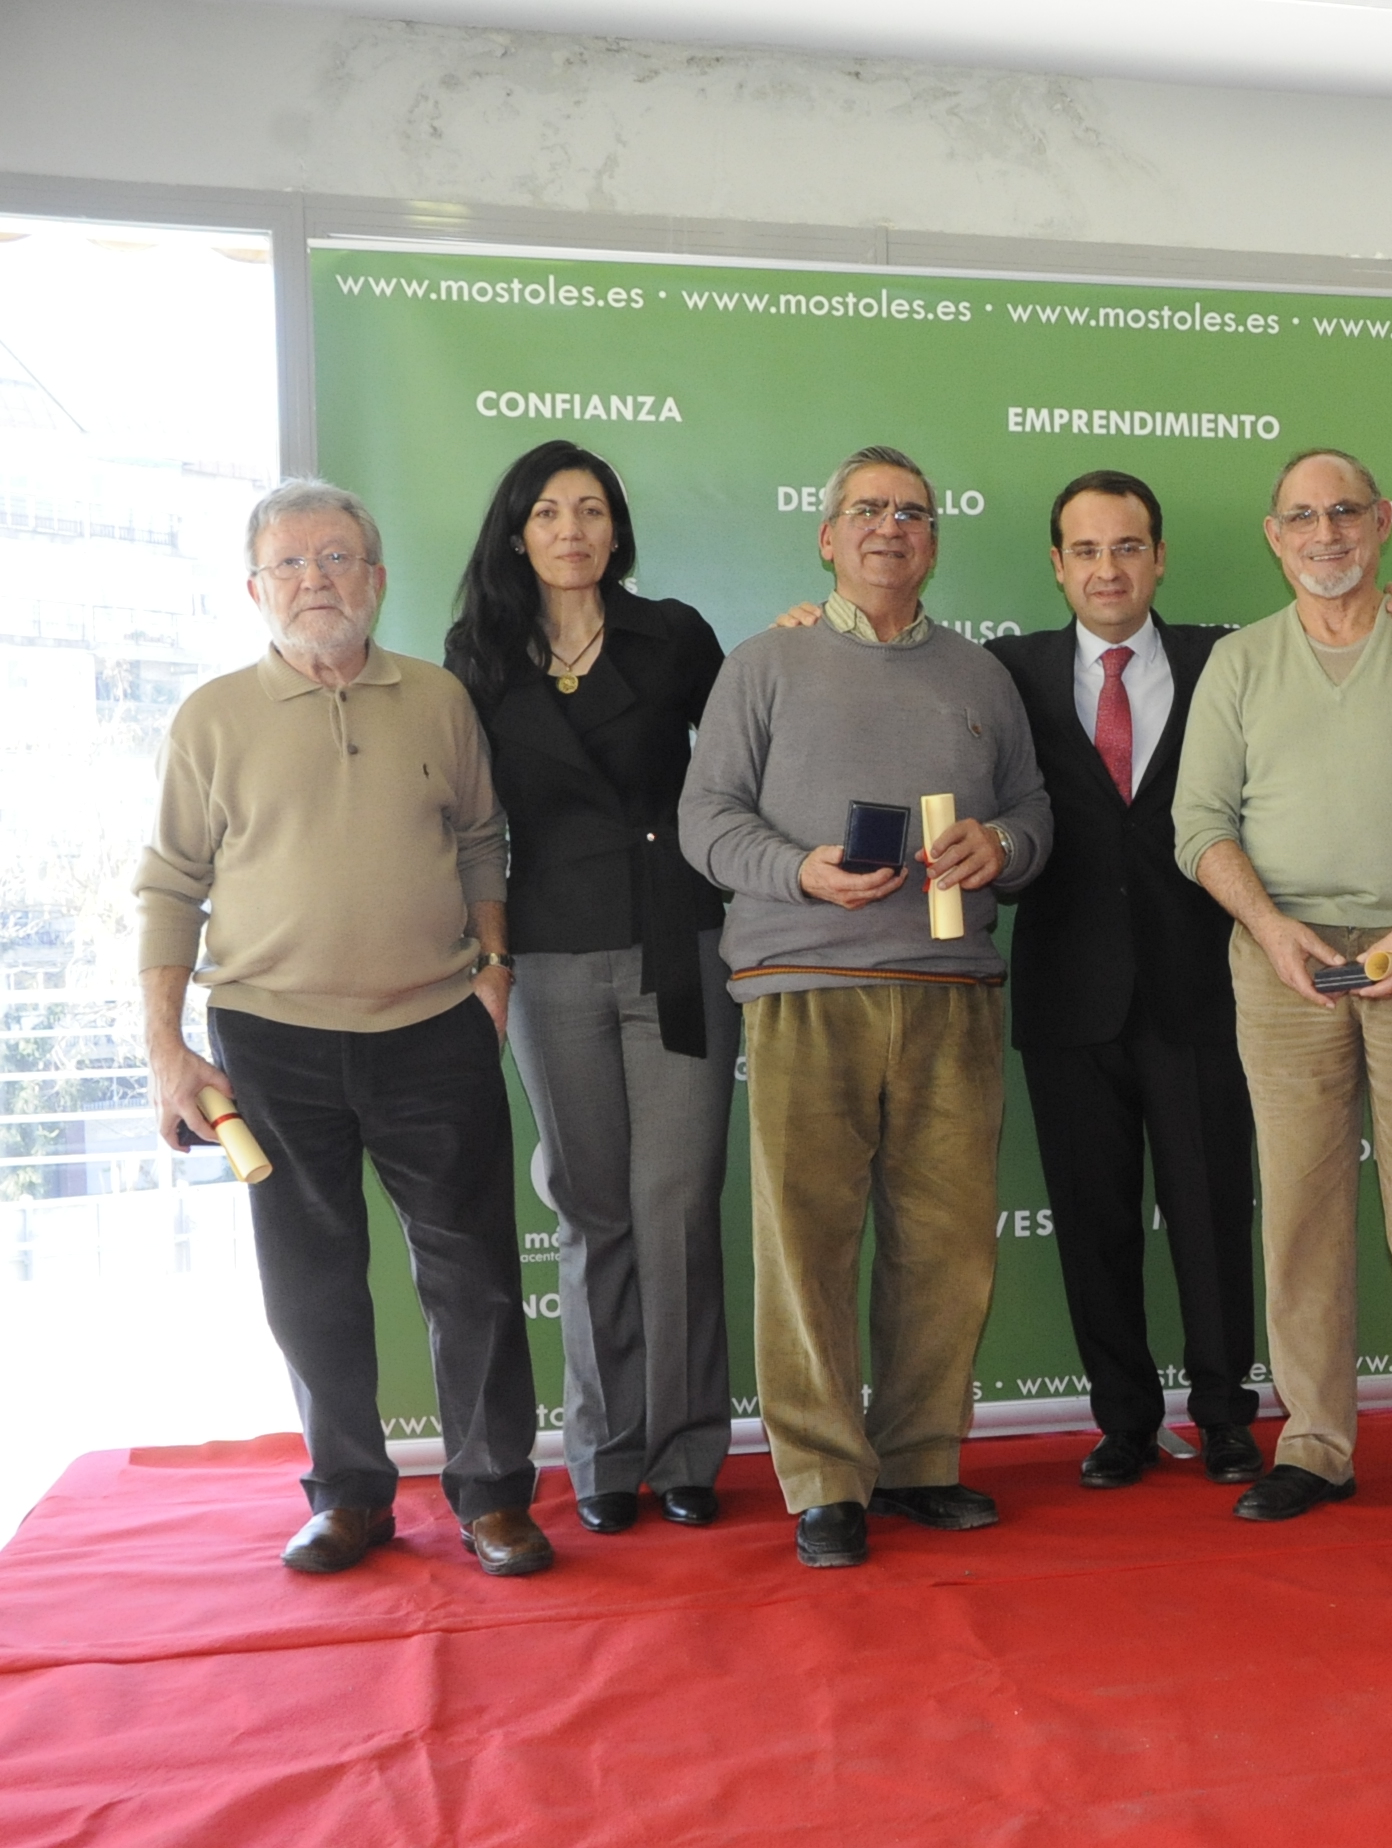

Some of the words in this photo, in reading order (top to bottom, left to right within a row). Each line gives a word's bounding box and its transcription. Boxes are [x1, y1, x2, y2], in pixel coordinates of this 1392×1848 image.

[335, 274, 644, 309] www.mostoles.es
[681, 288, 972, 322] www.mostoles.es
[1006, 302, 1280, 335] www.mostoles.es
[476, 390, 683, 422] CONFIANZA
[1008, 406, 1280, 440] EMPRENDIMIENTO
